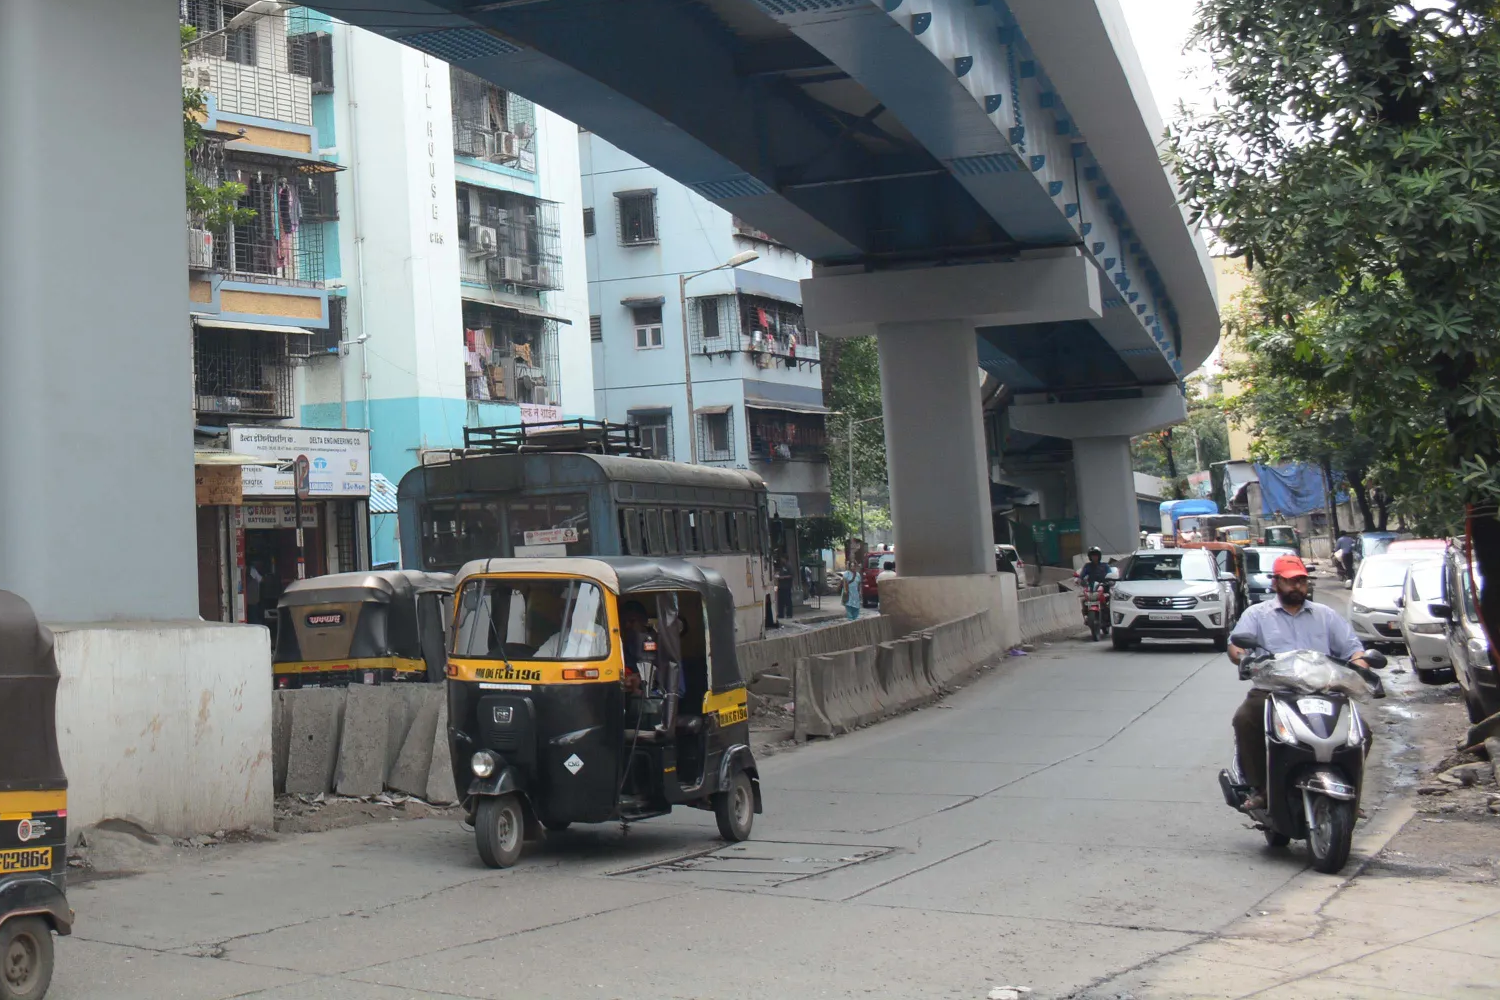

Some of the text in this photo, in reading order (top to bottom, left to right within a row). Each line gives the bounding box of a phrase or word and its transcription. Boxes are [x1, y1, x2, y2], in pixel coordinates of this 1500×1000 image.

[309, 436, 353, 445] DELTA ENGINEERING
[254, 506, 277, 515] EXIDE
